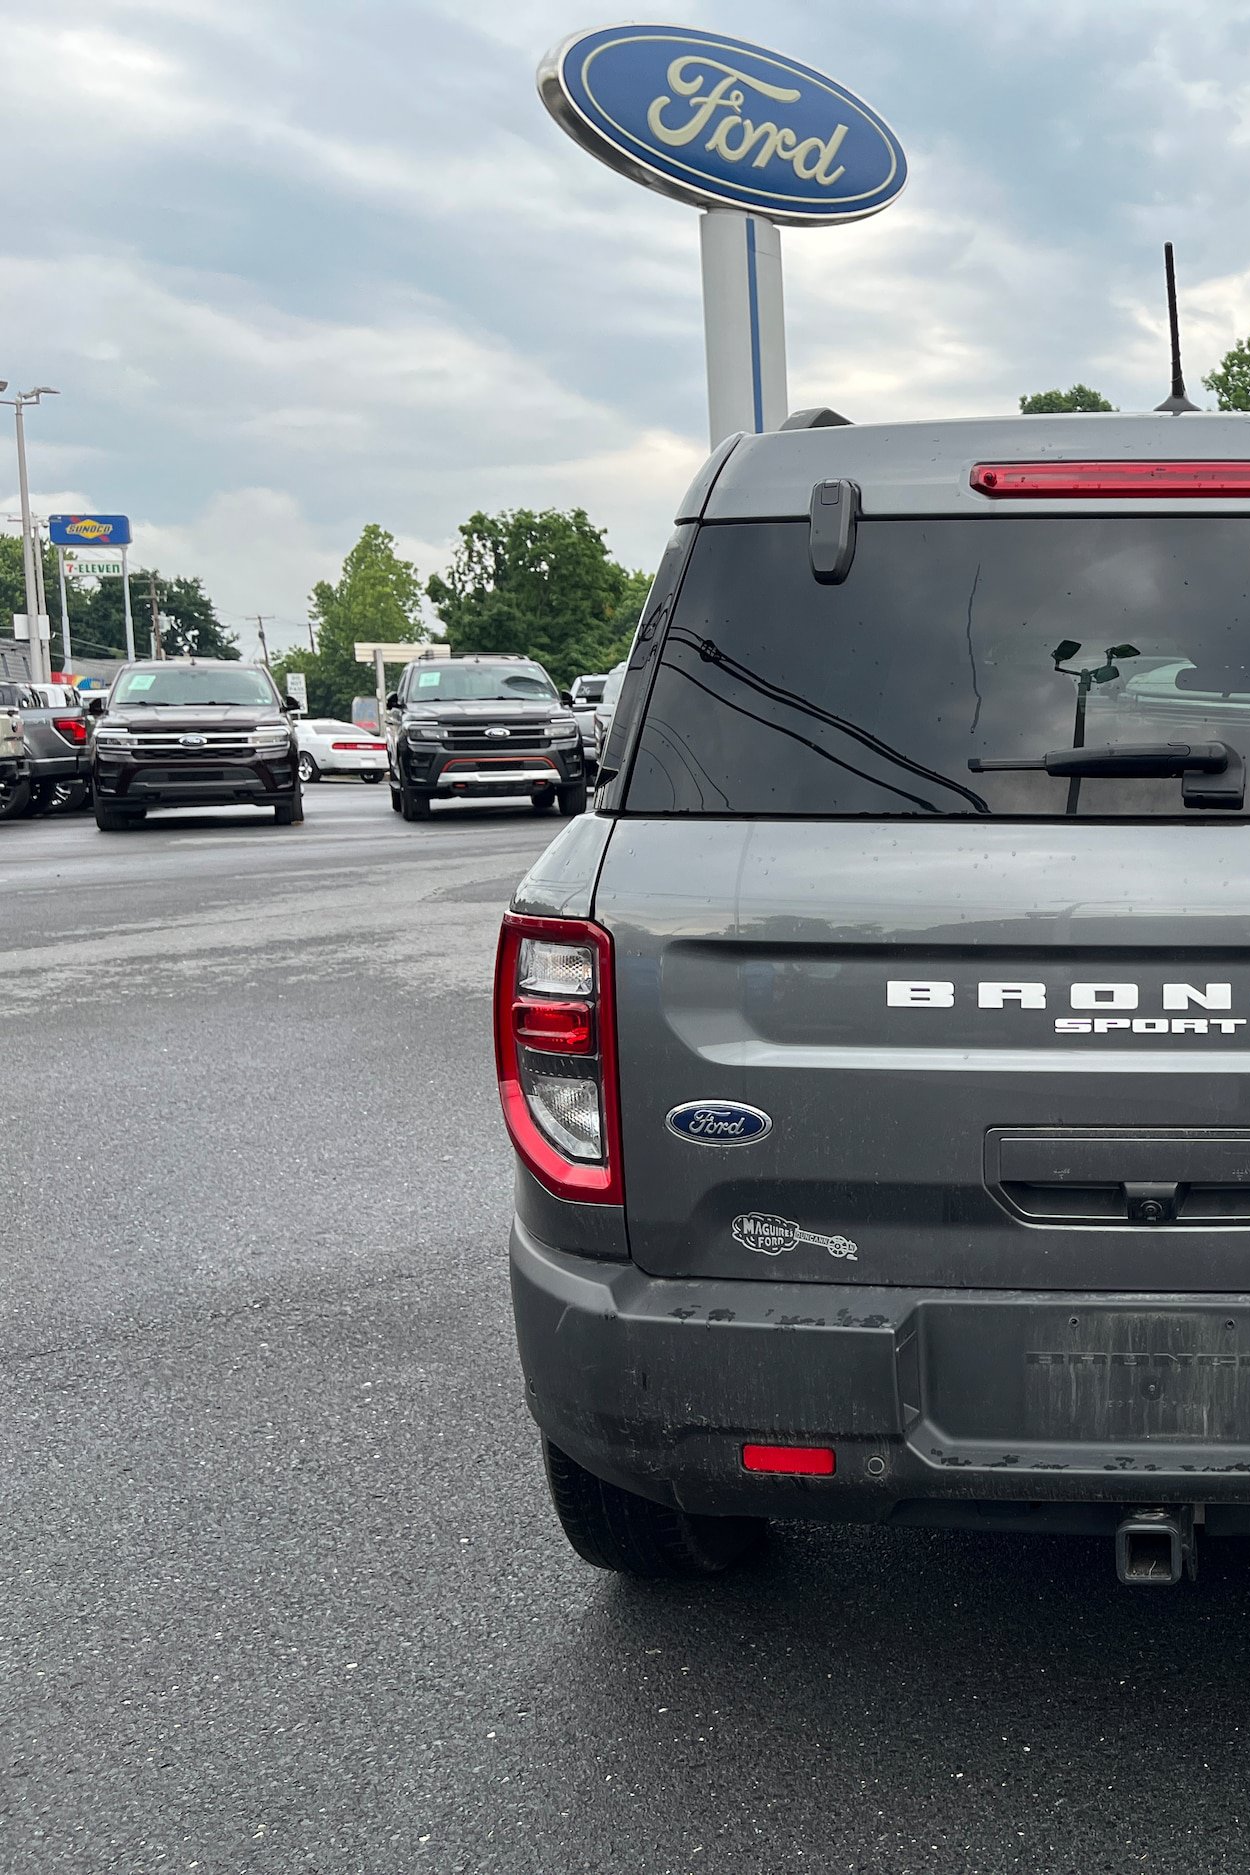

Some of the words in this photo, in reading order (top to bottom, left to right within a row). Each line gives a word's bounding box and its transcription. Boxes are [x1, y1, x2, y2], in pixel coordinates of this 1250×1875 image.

[647, 55, 849, 185] Ford
[67, 524, 111, 534] SUNOCO
[1054, 1018, 1247, 1034] SPORT
[689, 1109, 745, 1135] Ford
[758, 1236, 784, 1248] FORD
